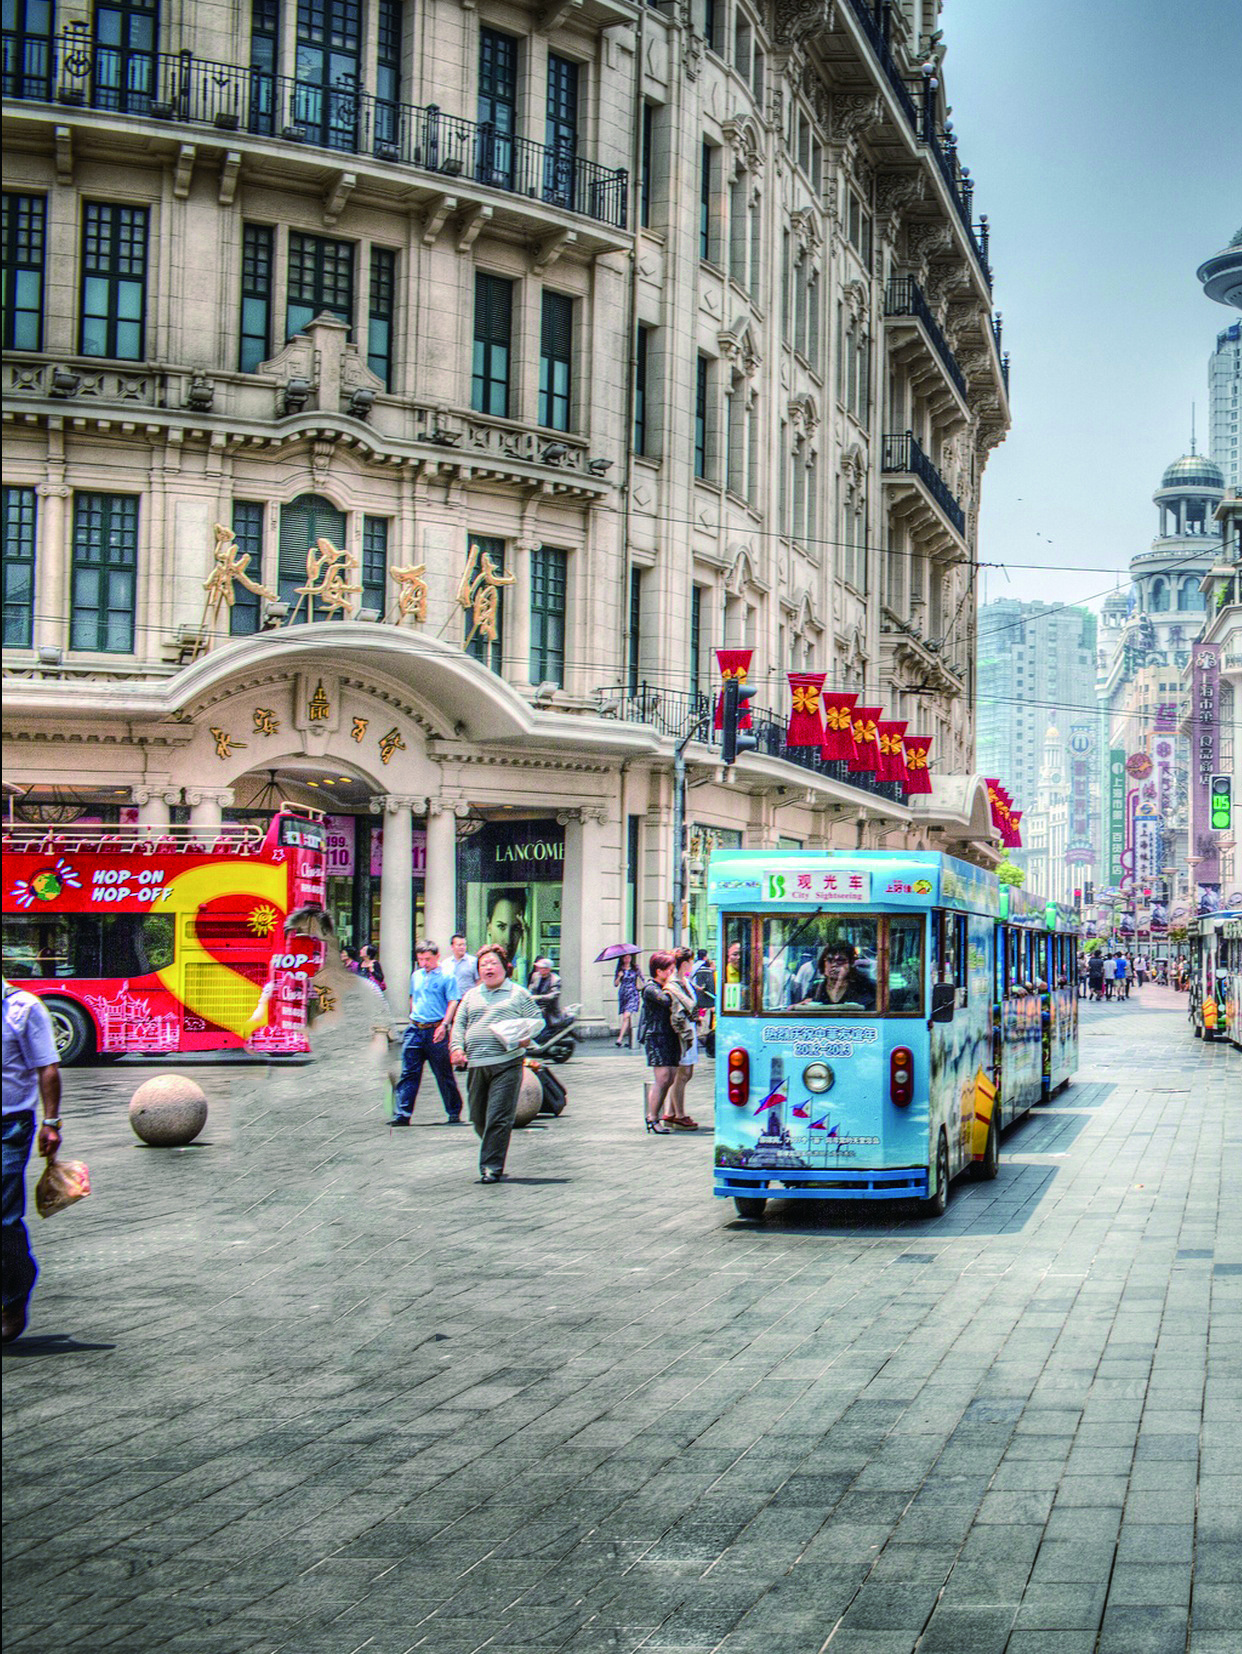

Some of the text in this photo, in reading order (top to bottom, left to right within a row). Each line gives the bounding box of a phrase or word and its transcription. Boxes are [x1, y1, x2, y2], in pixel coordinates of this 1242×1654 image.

[1213, 795, 1230, 810] 05
[496, 840, 564, 862] LANCÔME
[92, 869, 165, 885] HOP-ON
[797, 874, 863, 890] 观光车
[91, 886, 174, 902] HOP-OFF
[791, 891, 863, 901] City Sightseeing
